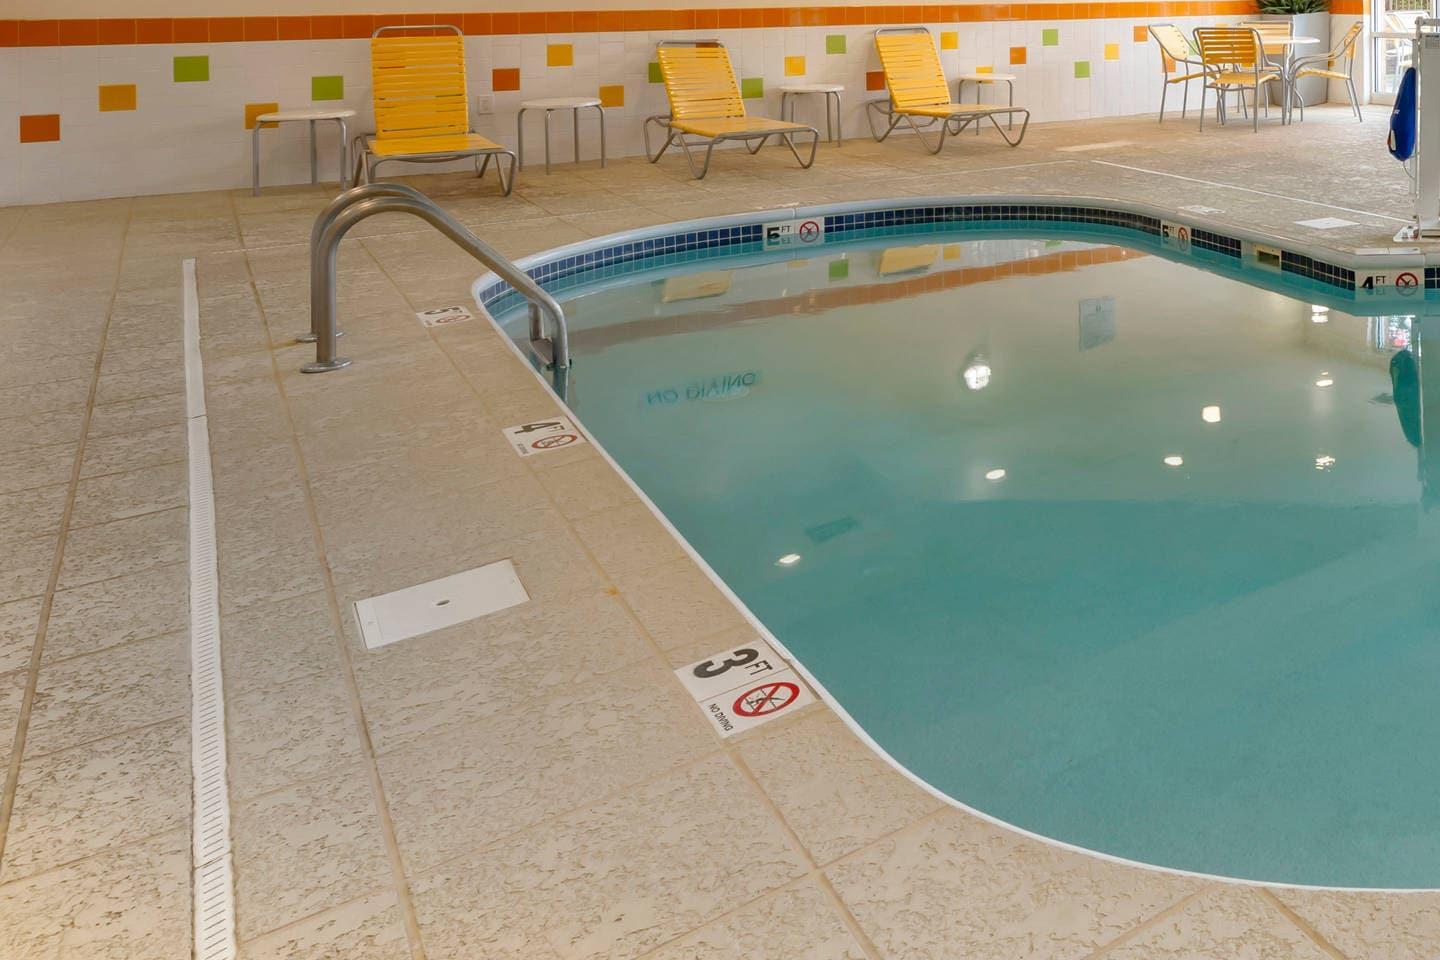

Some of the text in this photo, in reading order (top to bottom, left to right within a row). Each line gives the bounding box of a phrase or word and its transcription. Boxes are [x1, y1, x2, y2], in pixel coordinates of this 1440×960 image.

[766, 225, 791, 239] 5 FT
[1359, 275, 1387, 289] 4 FT
[513, 421, 561, 435] 4
[693, 648, 774, 678] 3 FT
[708, 703, 735, 732] NO DIVING
